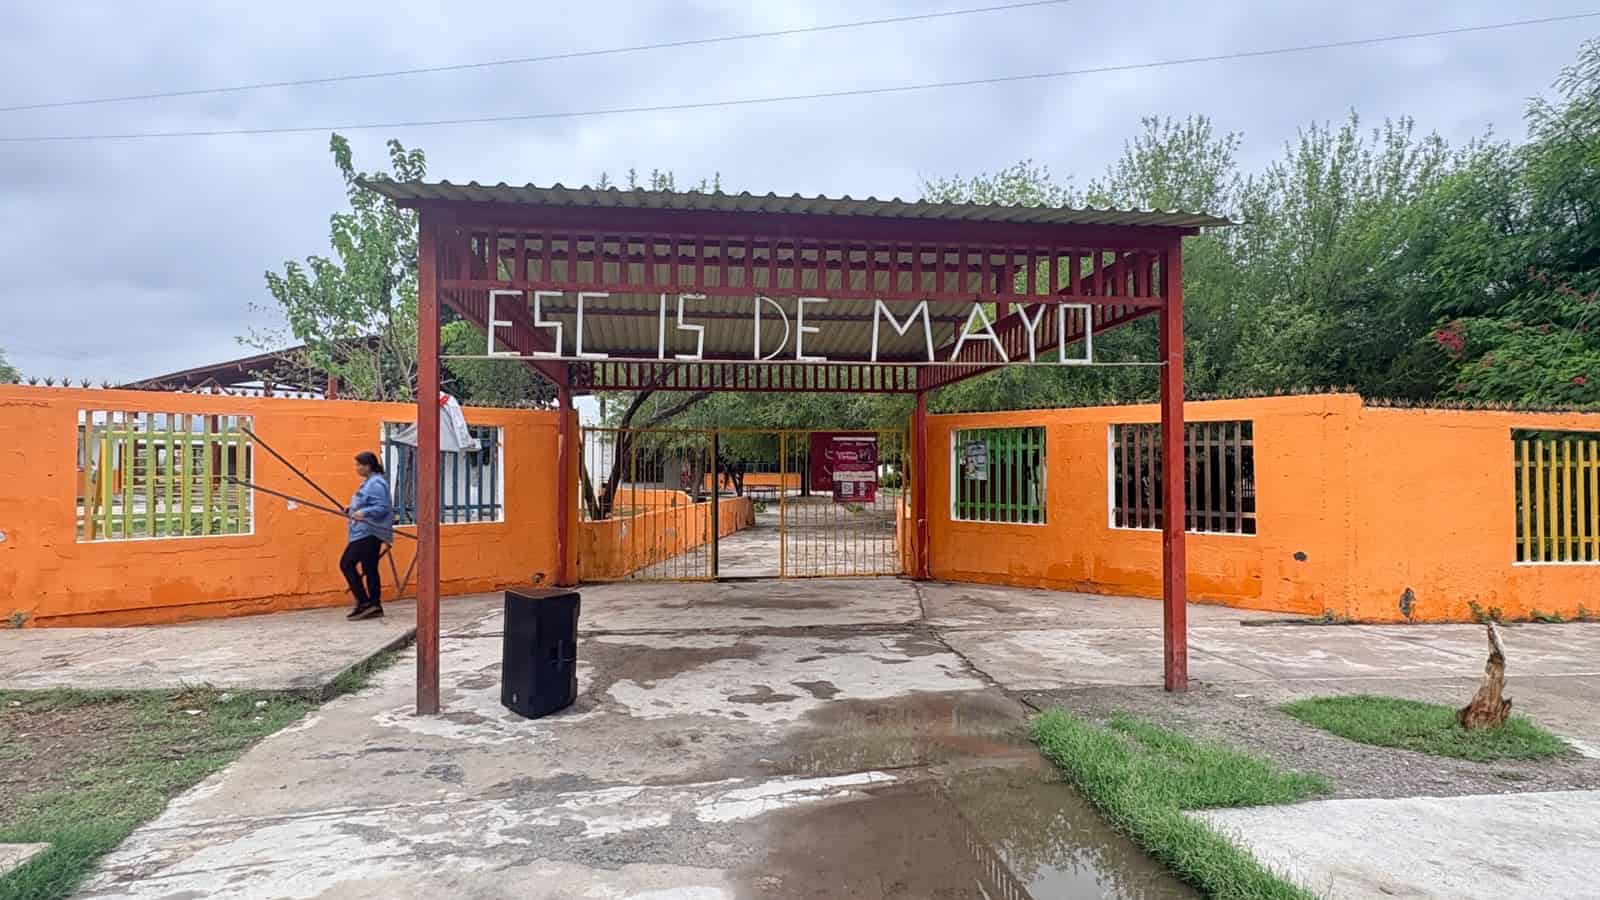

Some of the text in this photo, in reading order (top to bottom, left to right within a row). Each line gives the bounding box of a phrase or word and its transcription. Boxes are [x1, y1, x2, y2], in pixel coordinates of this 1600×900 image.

[487, 289, 609, 358] ESC
[754, 296, 828, 362] DE
[871, 298, 1092, 364] MAYO
